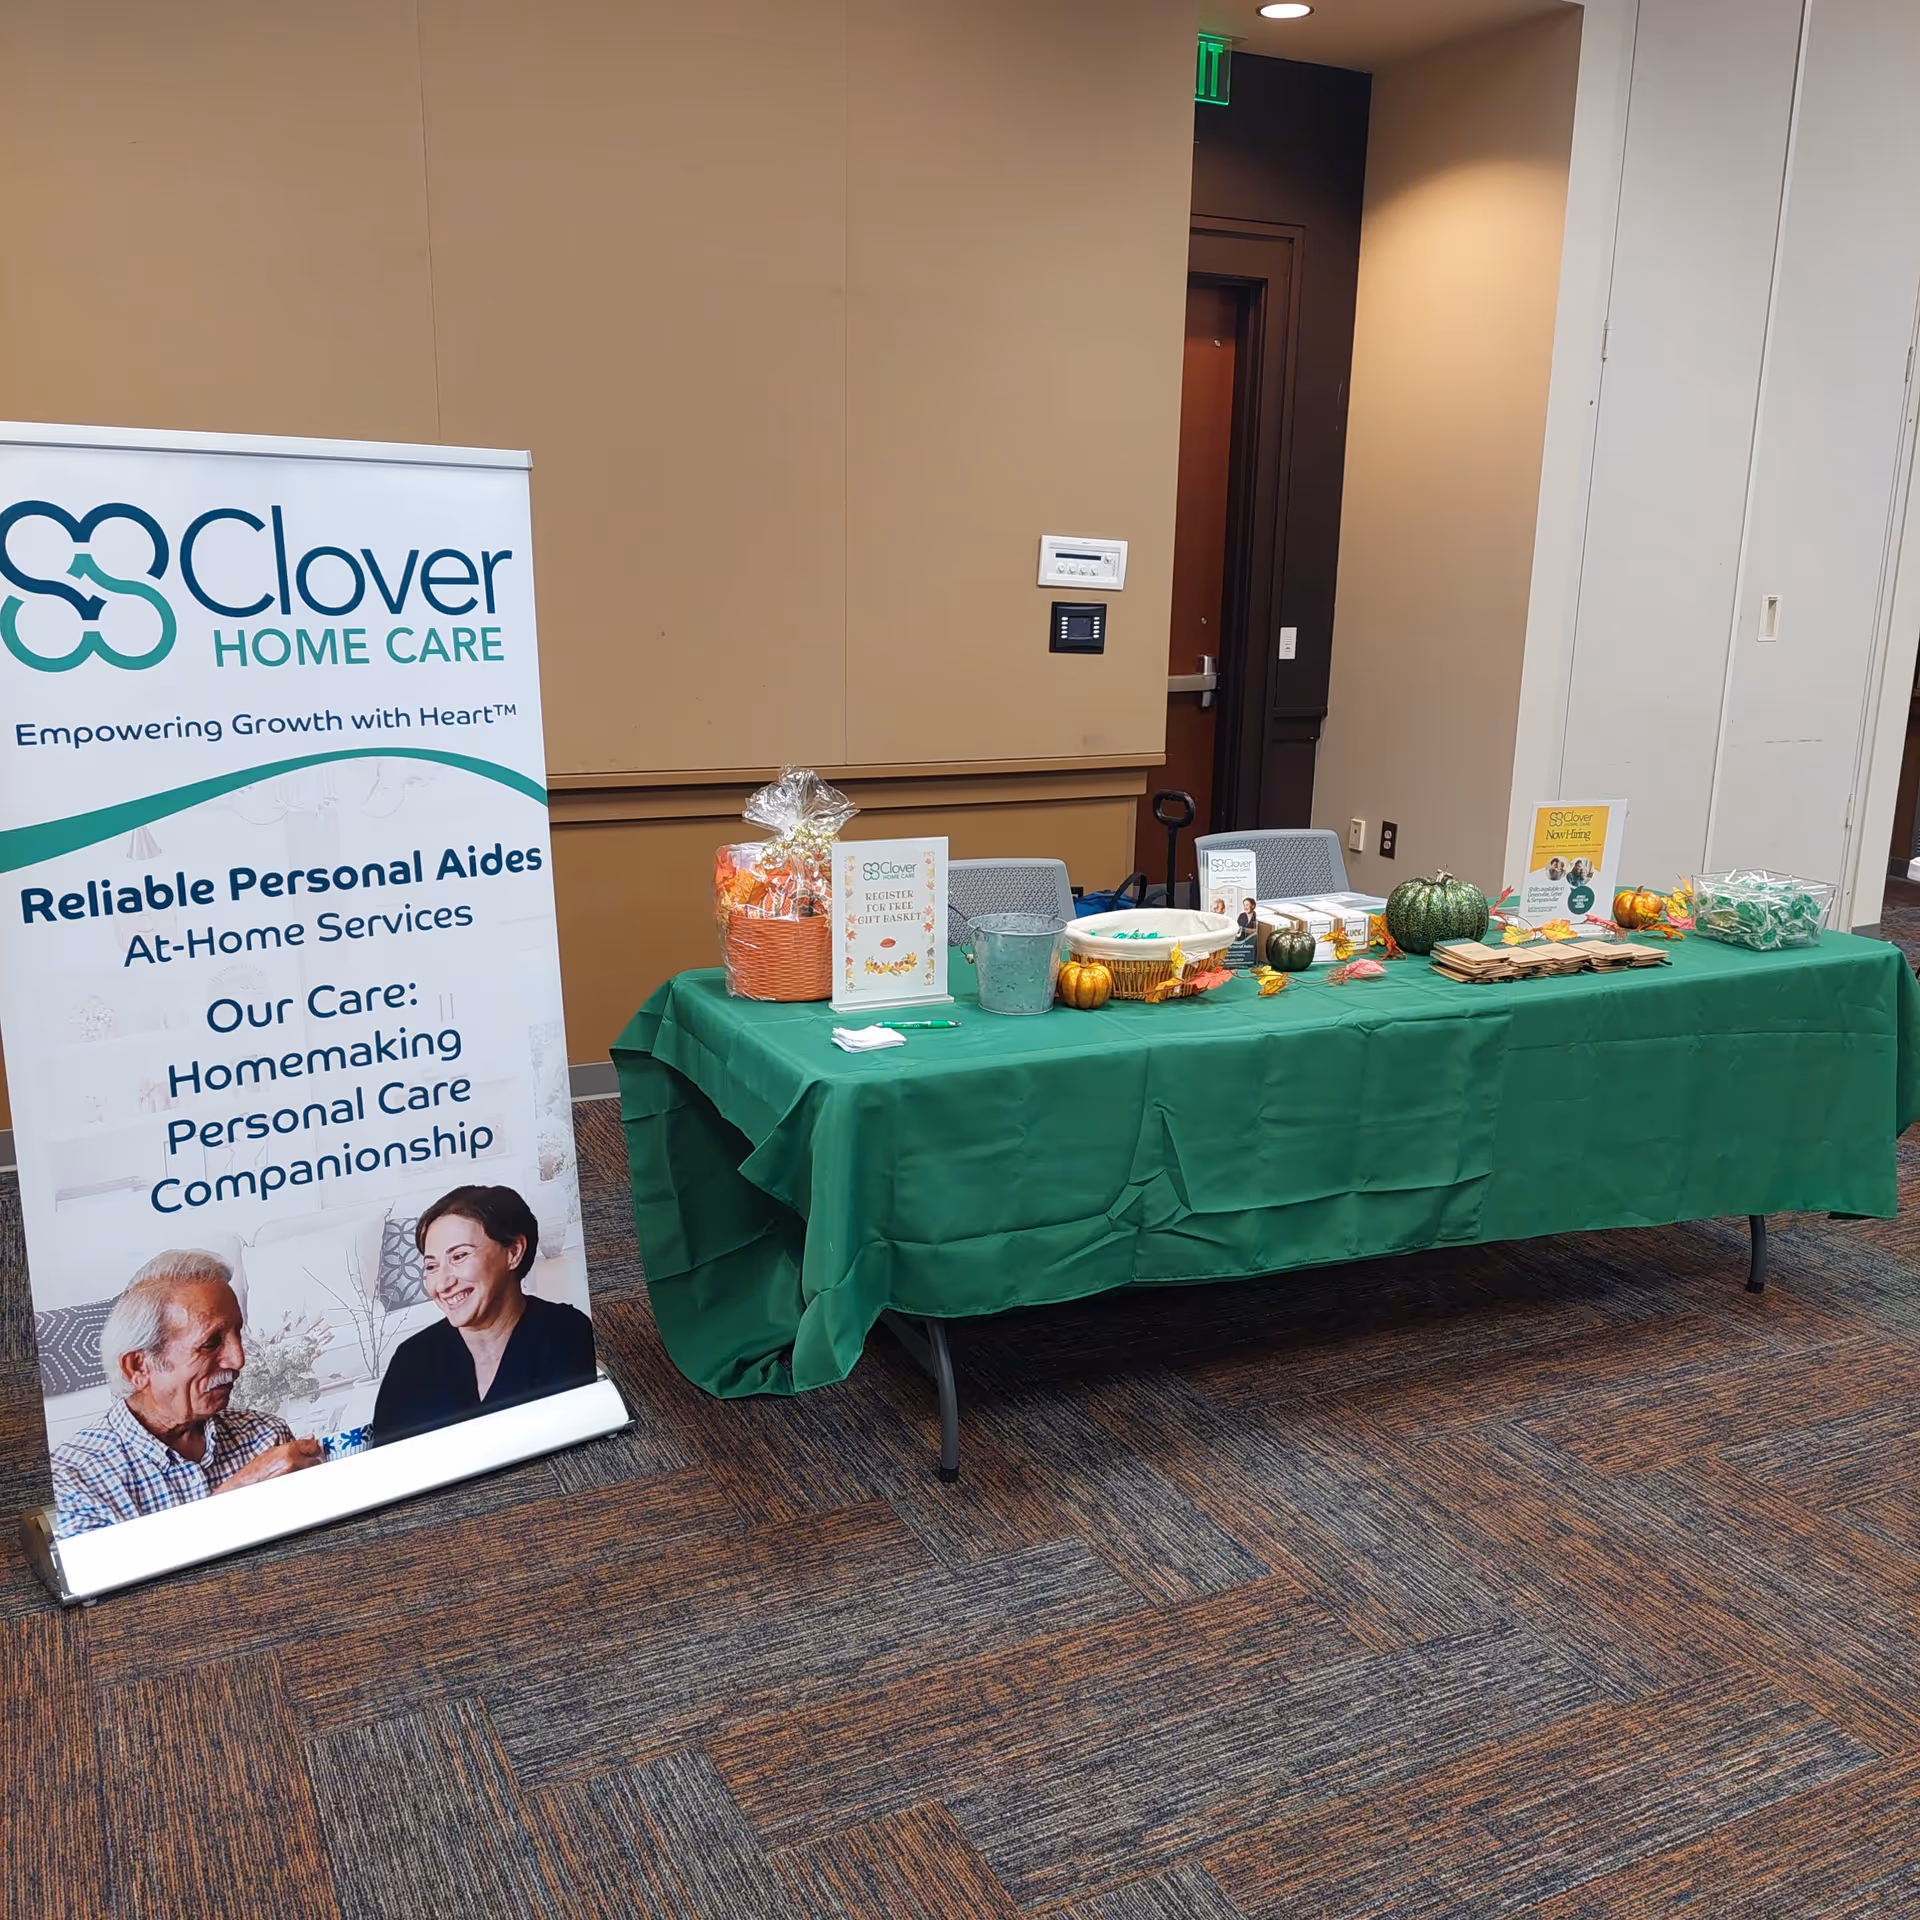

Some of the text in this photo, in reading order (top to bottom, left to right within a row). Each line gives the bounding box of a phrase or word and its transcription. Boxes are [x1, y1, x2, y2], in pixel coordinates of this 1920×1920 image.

[1198, 41, 1224, 97] IT
[180, 505, 513, 618] Clover
[213, 626, 505, 667] HOME CARE
[15, 715, 223, 748] Empowering
[231, 709, 343, 735] Growth
[351, 706, 411, 730] with
[1546, 828, 1592, 841] Now Hiring
[1563, 810, 1593, 822] Clover
[20, 843, 543, 924] Reliable Personal Aides
[881, 861, 917, 874] Clover
[1225, 859, 1252, 868] Clover
[865, 890, 913, 901] REGISTER
[866, 901, 913, 912] FOR FREE
[123, 903, 474, 967] At-Home Services
[858, 912, 921, 925] GIFT BASKET
[207, 982, 418, 1033] Our Care:
[168, 1027, 463, 1098] Homemaking
[167, 1077, 472, 1155] Personal Care
[151, 1122, 494, 1214] Companionship
